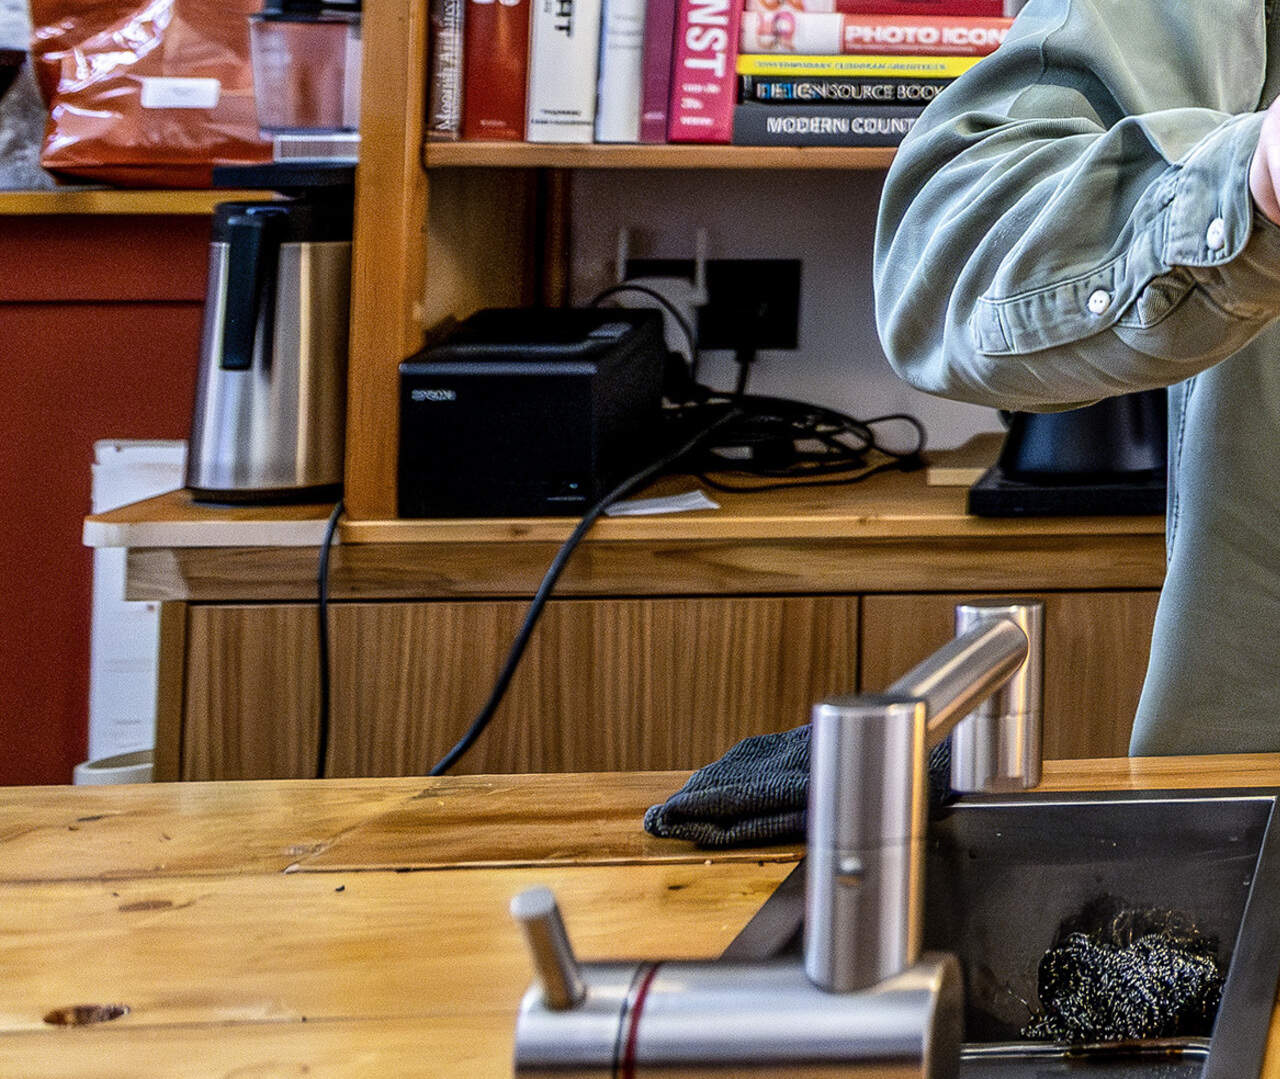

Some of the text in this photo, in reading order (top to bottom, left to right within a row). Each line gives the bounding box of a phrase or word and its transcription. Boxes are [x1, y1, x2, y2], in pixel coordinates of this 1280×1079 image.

[845, 24, 940, 44] PHOTO
[826, 83, 895, 100] SOURCE
[766, 116, 848, 134] MODERN
